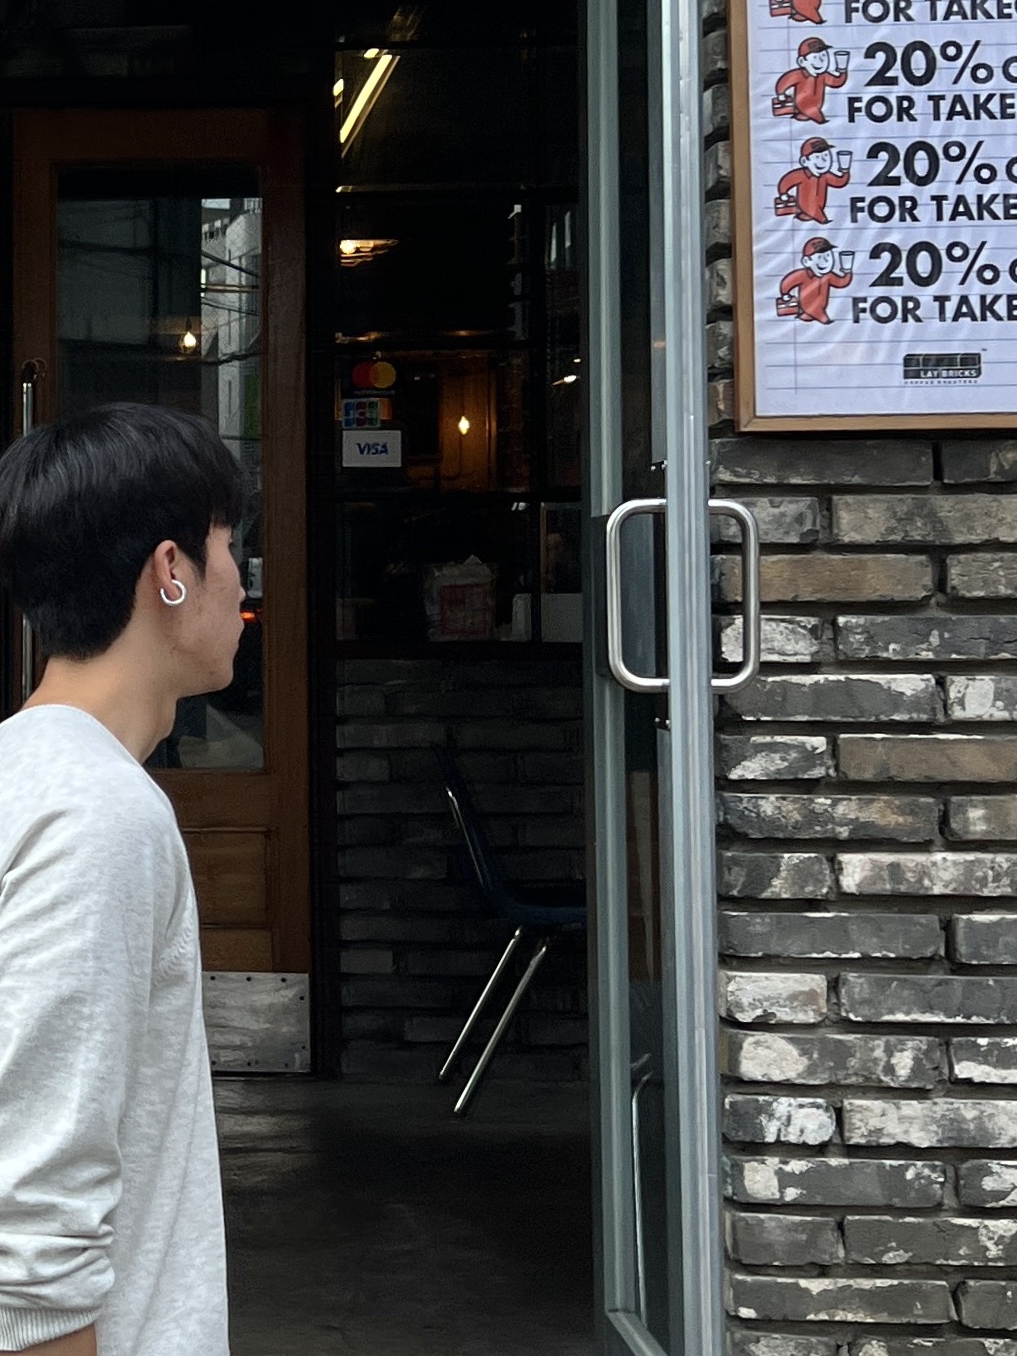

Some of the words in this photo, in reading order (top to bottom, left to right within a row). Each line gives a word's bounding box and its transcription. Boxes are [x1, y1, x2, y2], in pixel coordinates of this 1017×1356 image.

[845, 0, 915, 23] FOR
[925, 0, 1017, 21] TAKE
[848, 96, 917, 123] FOR
[928, 93, 1015, 121] TAKE
[850, 196, 920, 223] FOR
[930, 194, 1017, 221] TAKE
[852, 296, 923, 323] FOR
[933, 294, 1017, 322] TAKE
[356, 442, 388, 455] VISA
